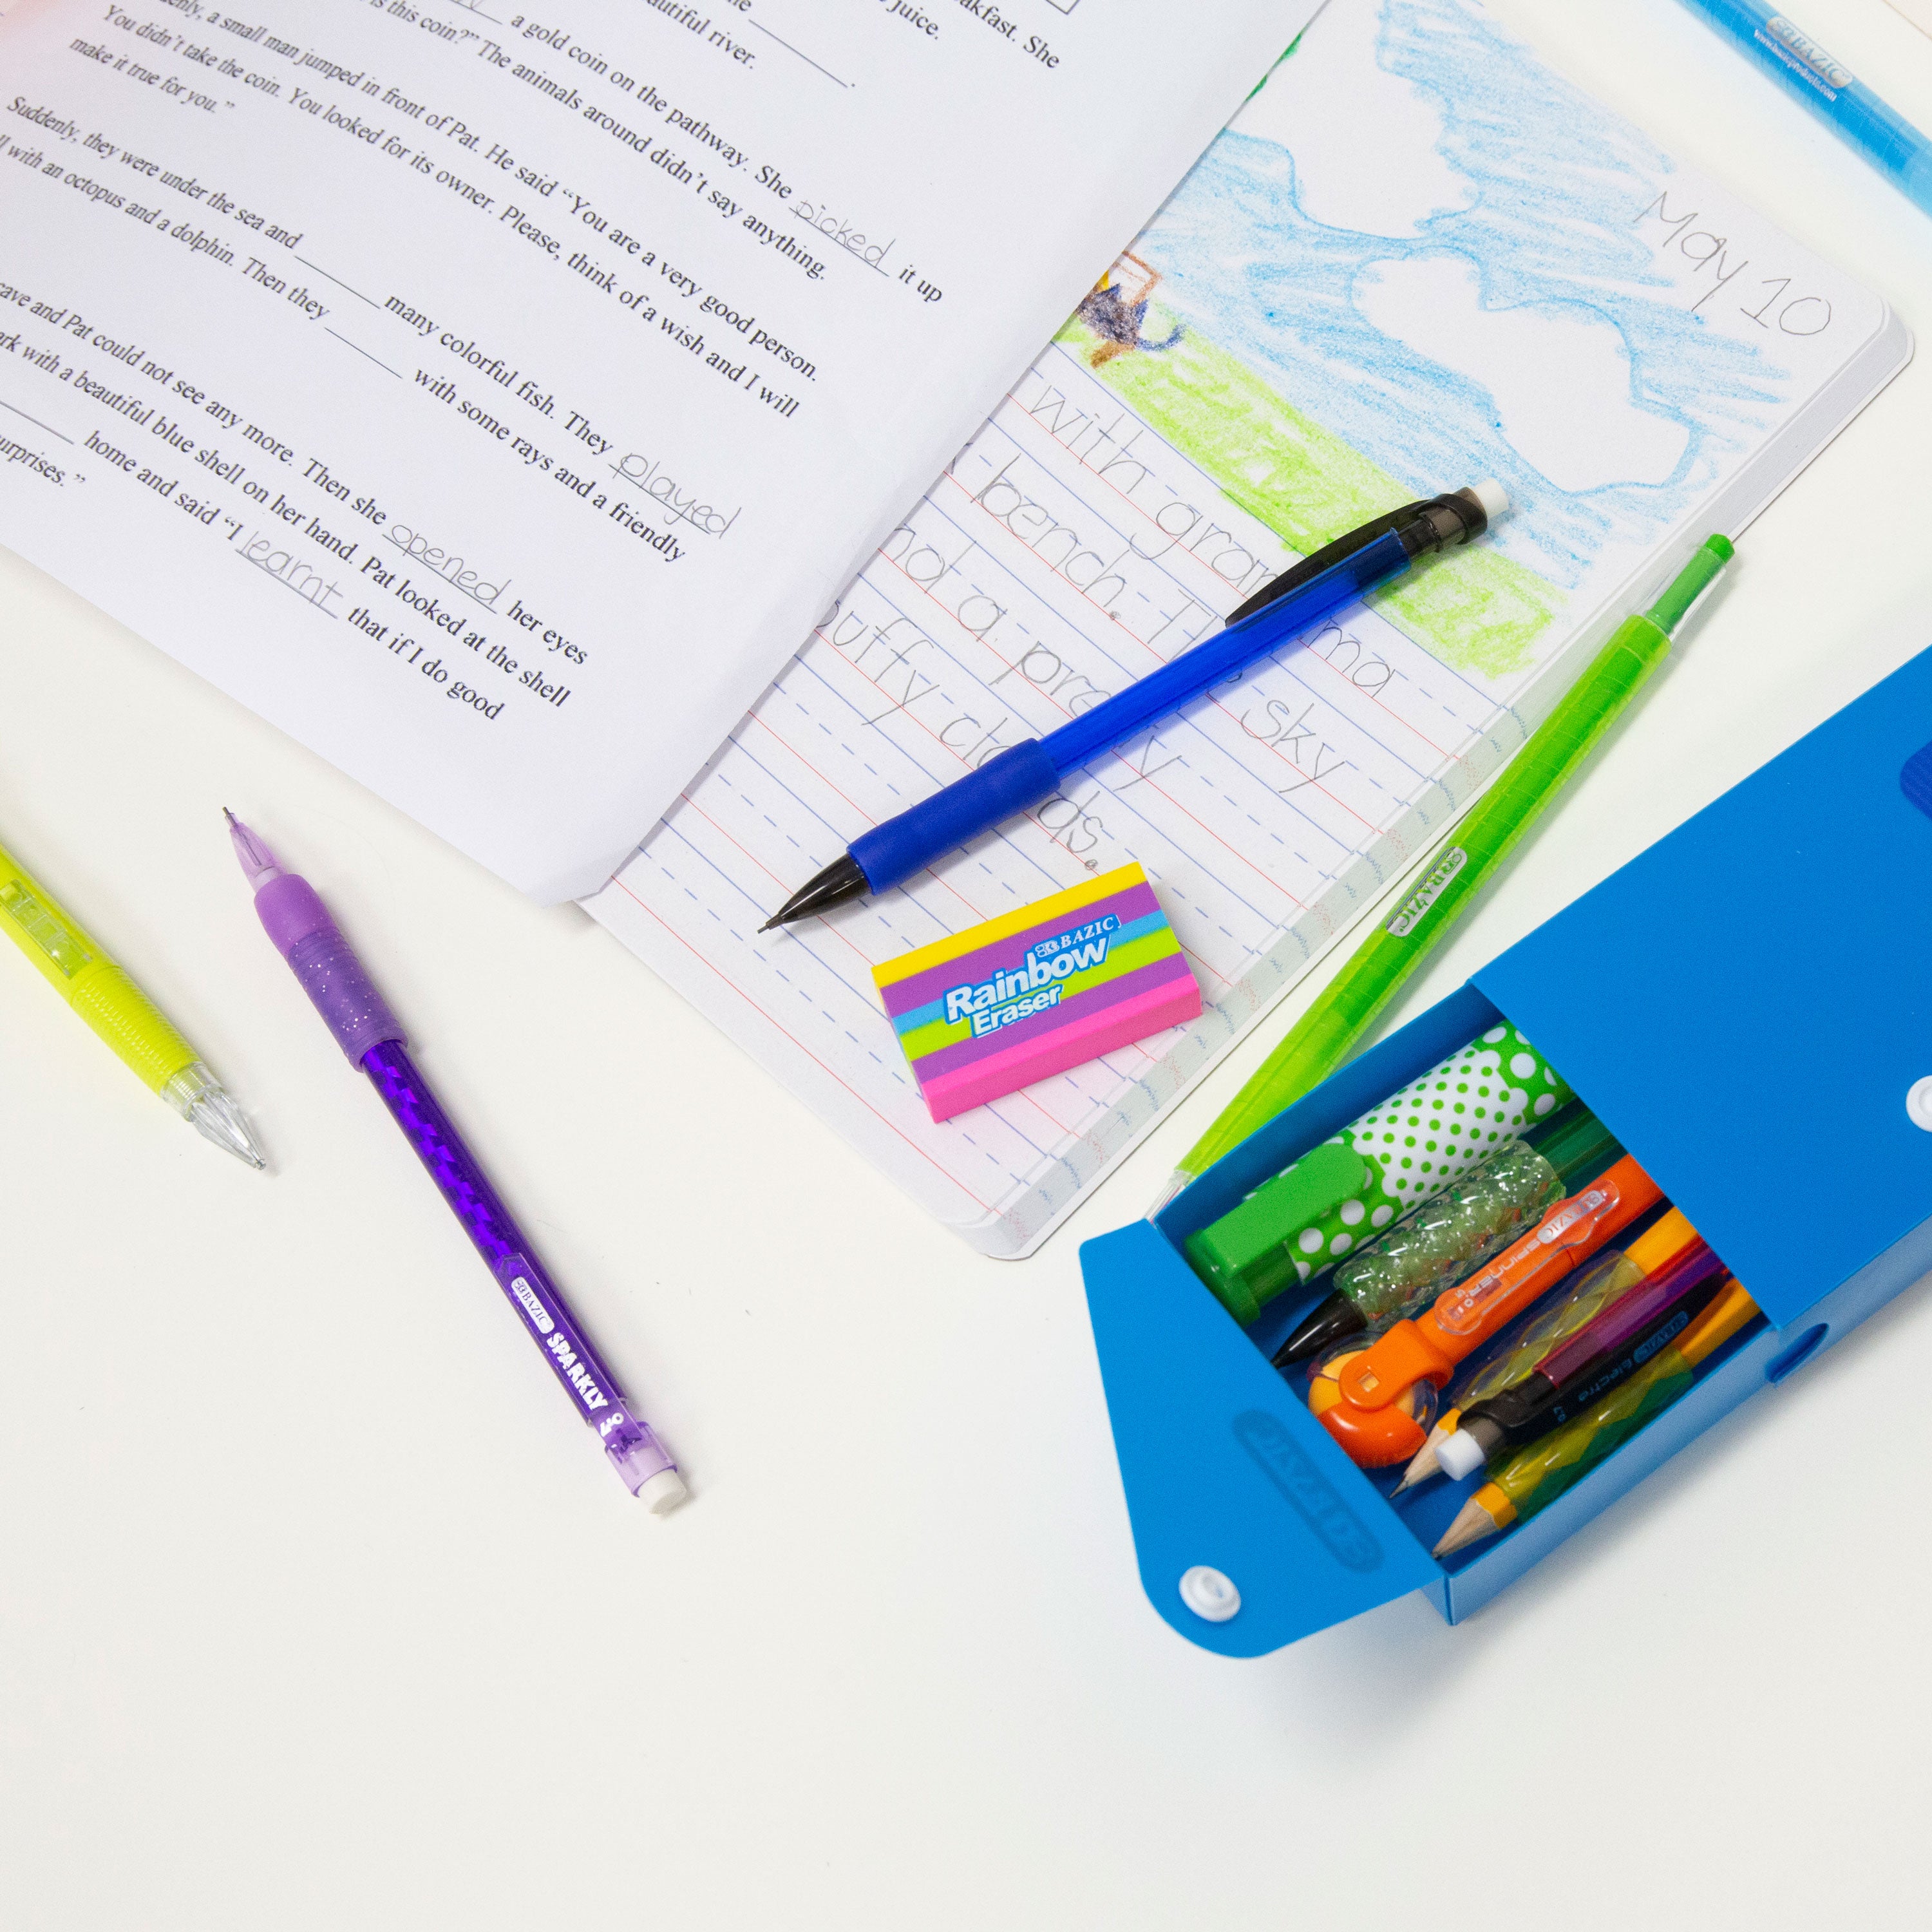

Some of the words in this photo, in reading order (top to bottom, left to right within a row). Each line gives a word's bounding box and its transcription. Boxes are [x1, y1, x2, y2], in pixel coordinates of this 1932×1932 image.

[69, 38, 114, 65] make
[113, 53, 129, 72] it
[126, 63, 161, 86] true
[159, 75, 187, 97] for
[386, 0, 420, 23] this
[477, 39, 512, 69] The
[511, 63, 583, 110] animals
[582, 106, 654, 154] around
[649, 147, 708, 195] didn’t
[706, 190, 744, 219] say
[741, 214, 826, 281] anything.
[510, 15, 526, 29] a
[521, 23, 571, 51] gold
[567, 46, 609, 75] coin
[609, 71, 636, 93] on
[636, 85, 668, 113] the
[665, 108, 750, 171] pathway.
[753, 164, 793, 200] She
[794, 200, 896, 269] picked
[898, 264, 917, 285] it
[916, 279, 943, 303] up
[707, 30, 756, 70] river.
[1022, 35, 1061, 70] She
[6, 96, 80, 142] Suddenly,
[82, 132, 121, 159] they
[119, 151, 160, 178] were
[160, 171, 209, 200] under
[207, 191, 236, 215] the
[233, 209, 266, 231] sea
[263, 224, 305, 250] and
[383, 295, 440, 337] many
[439, 332, 520, 388] colorful
[515, 380, 555, 420] fish.
[564, 410, 614, 456] They
[612, 452, 742, 540] played
[104, 4, 136, 31] You
[135, 22, 185, 52] didn’t
[182, 44, 219, 68] take
[217, 59, 244, 79] the
[244, 75, 281, 97] coin.
[288, 86, 323, 116] You
[321, 104, 386, 145] looked
[380, 135, 412, 160] for
[410, 151, 435, 175] its
[435, 170, 496, 214] owner.
[498, 204, 562, 261] Please,
[566, 252, 618, 295] think
[618, 290, 650, 311] of
[641, 306, 658, 323] a
[660, 316, 705, 356] wish
[705, 352, 748, 383] and
[743, 373, 761, 392] I
[759, 386, 801, 419] will
[207, 12, 220, 24] a
[219, 17, 268, 43] small
[262, 35, 300, 59] man
[294, 48, 366, 88] jumped
[360, 80, 381, 97] in
[380, 87, 426, 120] front
[426, 114, 454, 129] of
[446, 122, 480, 153] Pat.
[484, 143, 515, 171] He
[514, 166, 560, 198] said
[607, 228, 641, 255] are
[640, 251, 657, 267] a
[659, 261, 703, 298] very
[698, 294, 756, 335] good
[747, 328, 817, 383] person.
[1633, 191, 1748, 312] May
[1740, 278, 1832, 336] 10
[7, 147, 43, 169] with
[41, 162, 64, 179] an
[64, 173, 126, 208] octopus
[125, 202, 162, 224] and
[156, 218, 171, 232] a
[169, 222, 235, 265] dolphin.
[242, 256, 287, 295] Then
[287, 287, 331, 321] they
[414, 368, 457, 405] with
[456, 400, 511, 441] some
[509, 436, 555, 471] rays
[553, 467, 598, 499] and
[591, 493, 609, 510] a
[608, 501, 687, 564] friendly
[29, 301, 69, 325] and
[61, 313, 94, 341] Pat
[91, 334, 146, 367] could
[140, 360, 175, 386] not
[171, 379, 206, 406] see
[204, 400, 244, 430] any
[241, 423, 294, 466] more.
[302, 457, 352, 502] Then
[350, 497, 388, 526] she
[391, 524, 512, 605] opened
[506, 599, 544, 632] her
[542, 629, 589, 665] eyes
[1029, 384, 1151, 494] with
[22, 345, 61, 374] with
[58, 367, 74, 382] a
[73, 369, 156, 426] beautiful
[151, 415, 196, 454] blue
[193, 449, 247, 486] shell
[242, 480, 270, 504] on
[269, 493, 307, 526] her
[303, 516, 359, 565] hand.
[359, 555, 397, 590] Pat
[394, 578, 468, 637] looked
[462, 631, 487, 652] at
[485, 644, 519, 675] the
[518, 670, 572, 708] shell
[83, 429, 138, 473] home
[135, 468, 180, 498] and
[173, 493, 222, 526] said
[240, 530, 345, 607] learnt
[346, 607, 389, 642] that
[387, 632, 416, 656] if
[406, 646, 425, 665] I
[421, 658, 449, 684] do
[445, 681, 506, 721] good
[971, 453, 1130, 620] bench.
[1240, 698, 1345, 793] sky
[945, 936, 1107, 1023] Rainbow
[972, 985, 1062, 1036] Eraser
[1059, 916, 1115, 949] BAZIC
[545, 1332, 609, 1410] SPARKLY
